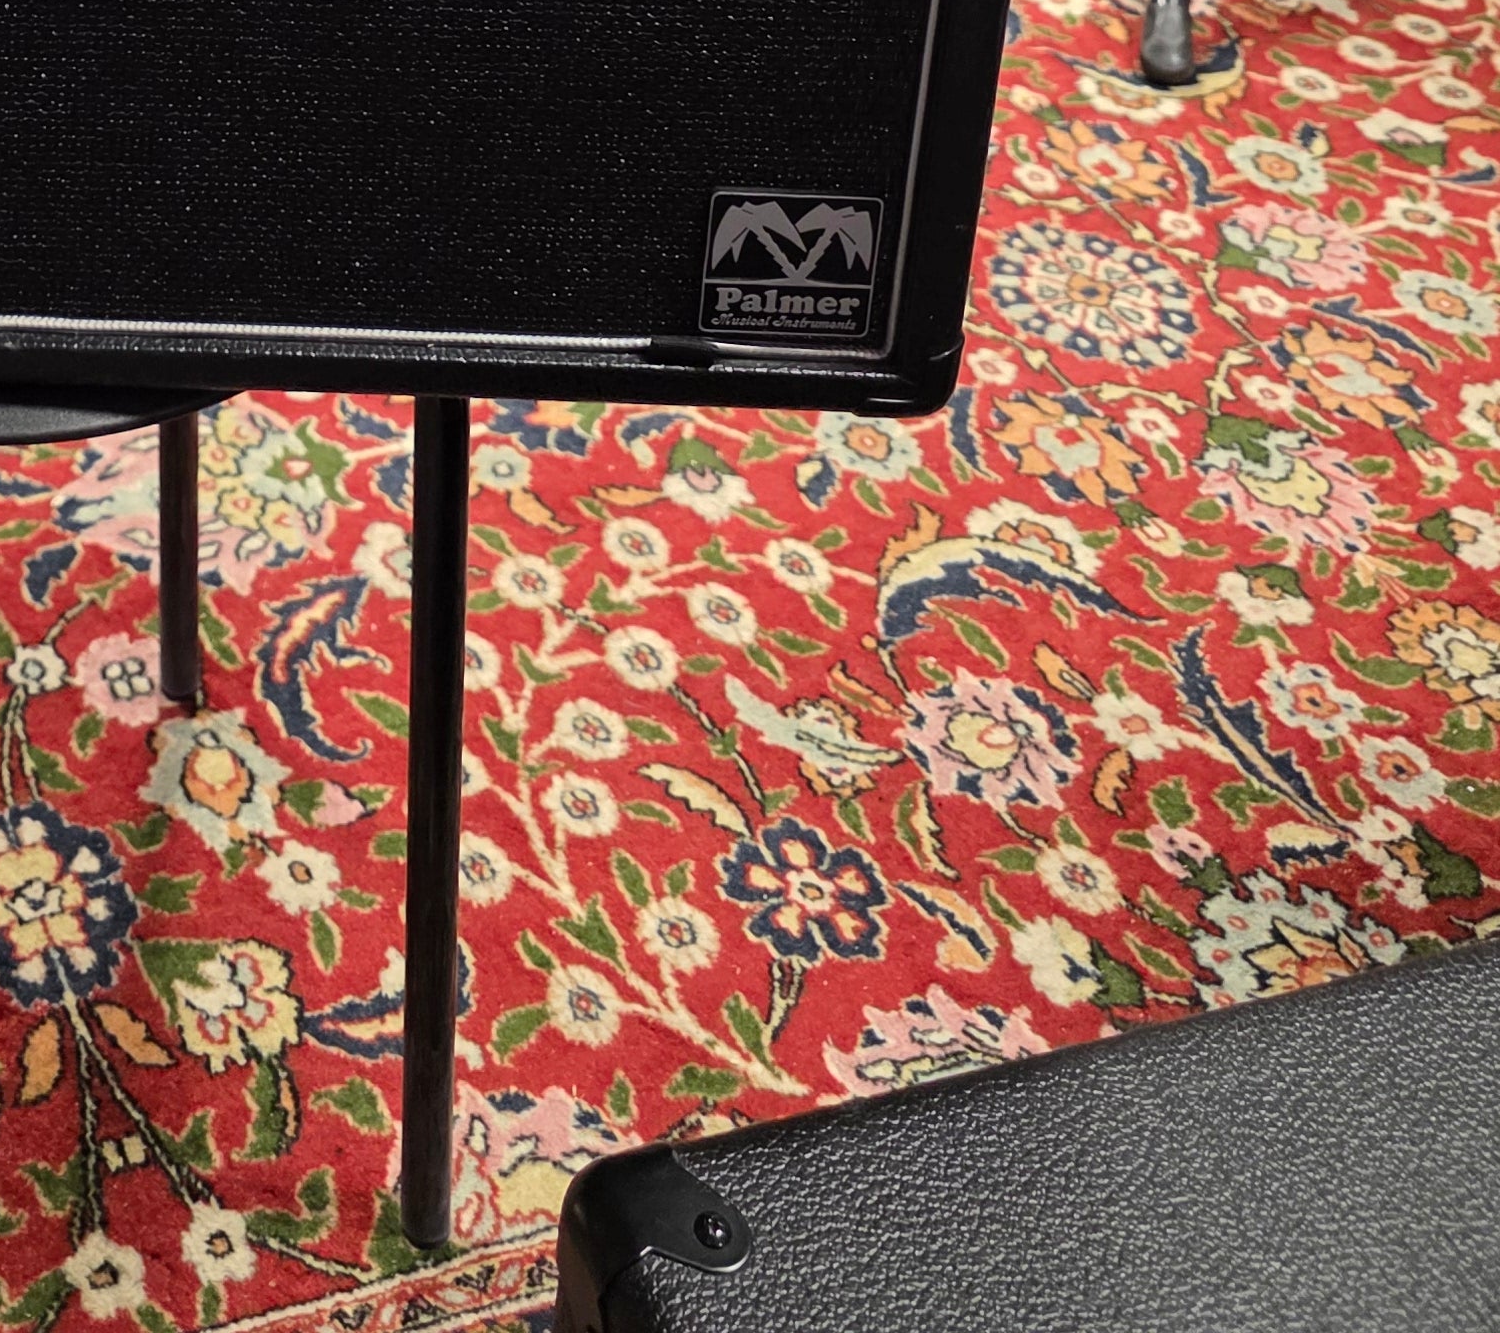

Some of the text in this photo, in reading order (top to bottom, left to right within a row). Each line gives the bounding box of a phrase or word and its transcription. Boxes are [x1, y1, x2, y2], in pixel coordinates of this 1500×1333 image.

[714, 287, 860, 316] Palmer
[711, 313, 856, 330] Musical Instruments
